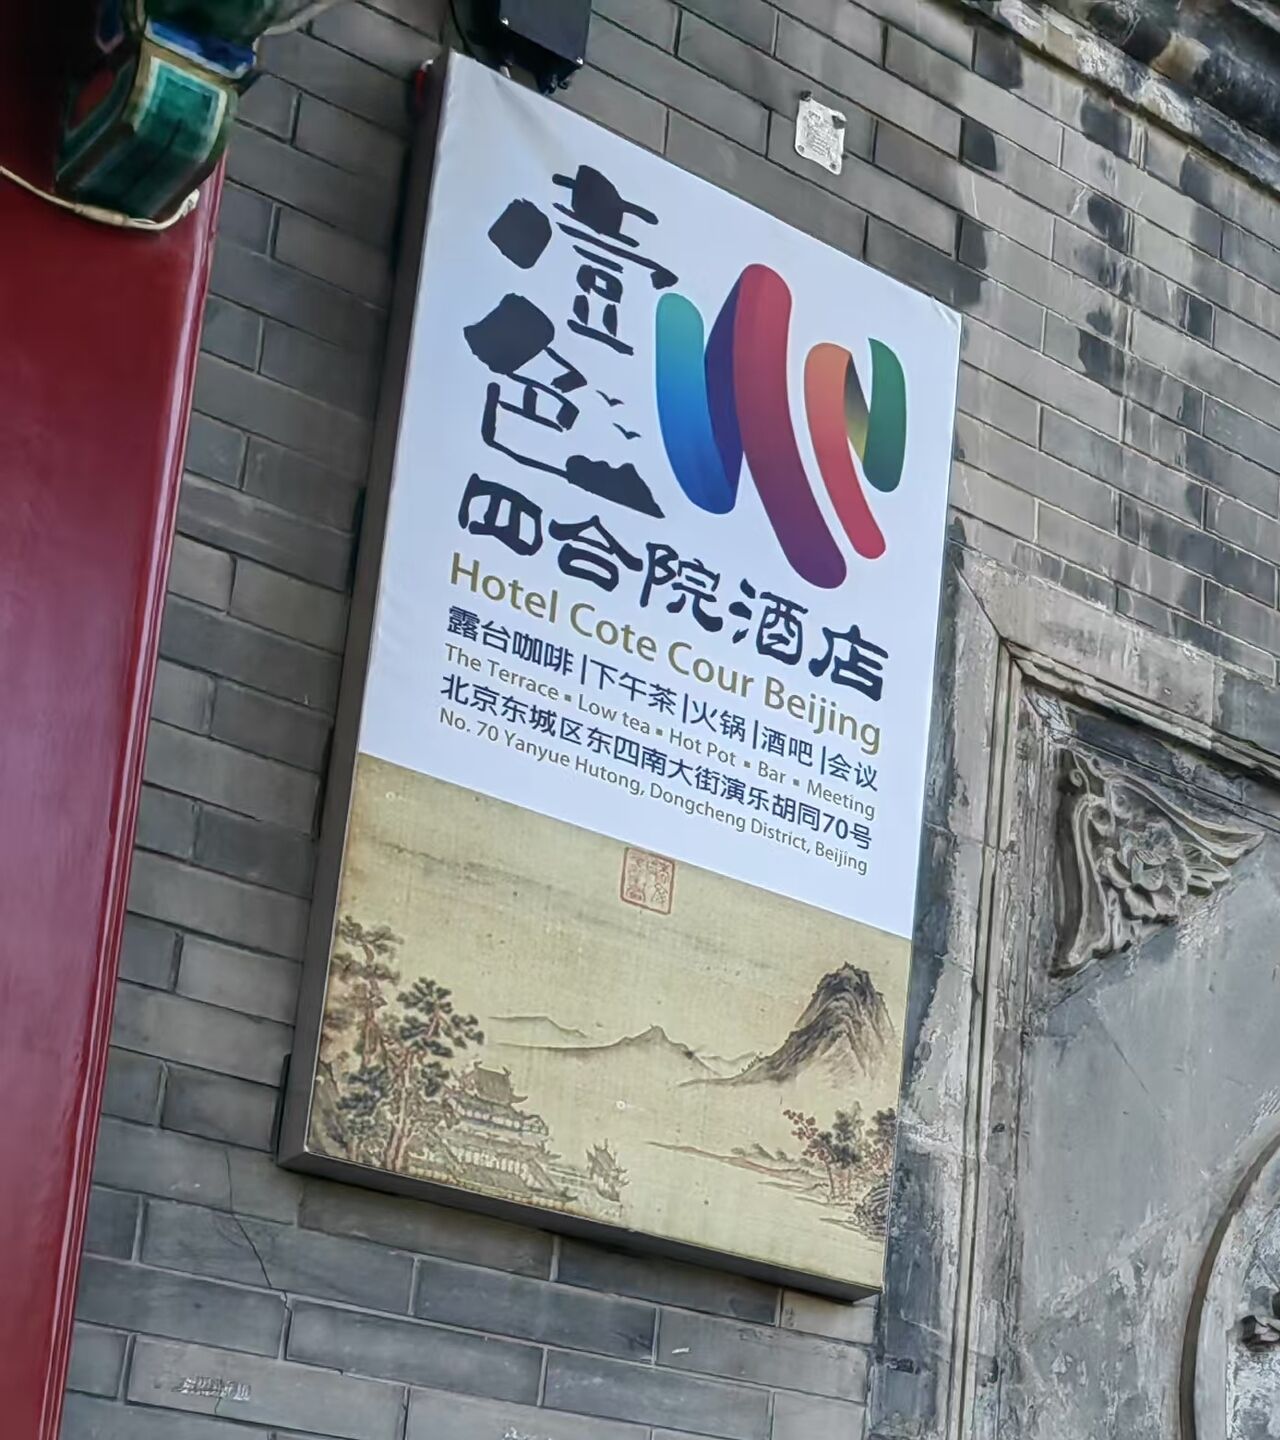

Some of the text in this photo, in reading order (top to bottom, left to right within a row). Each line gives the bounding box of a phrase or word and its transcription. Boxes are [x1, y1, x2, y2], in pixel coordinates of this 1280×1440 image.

[450, 551, 882, 756] Hotel Cote Cour Beijing
[457, 472, 889, 702] 四合院酒店
[439, 707, 868, 876] No. 70 Yanyue Hutong, Dongcheng District, Beijing
[445, 642, 876, 821] The Terrace Low tea Hot Pot Bar Meeting
